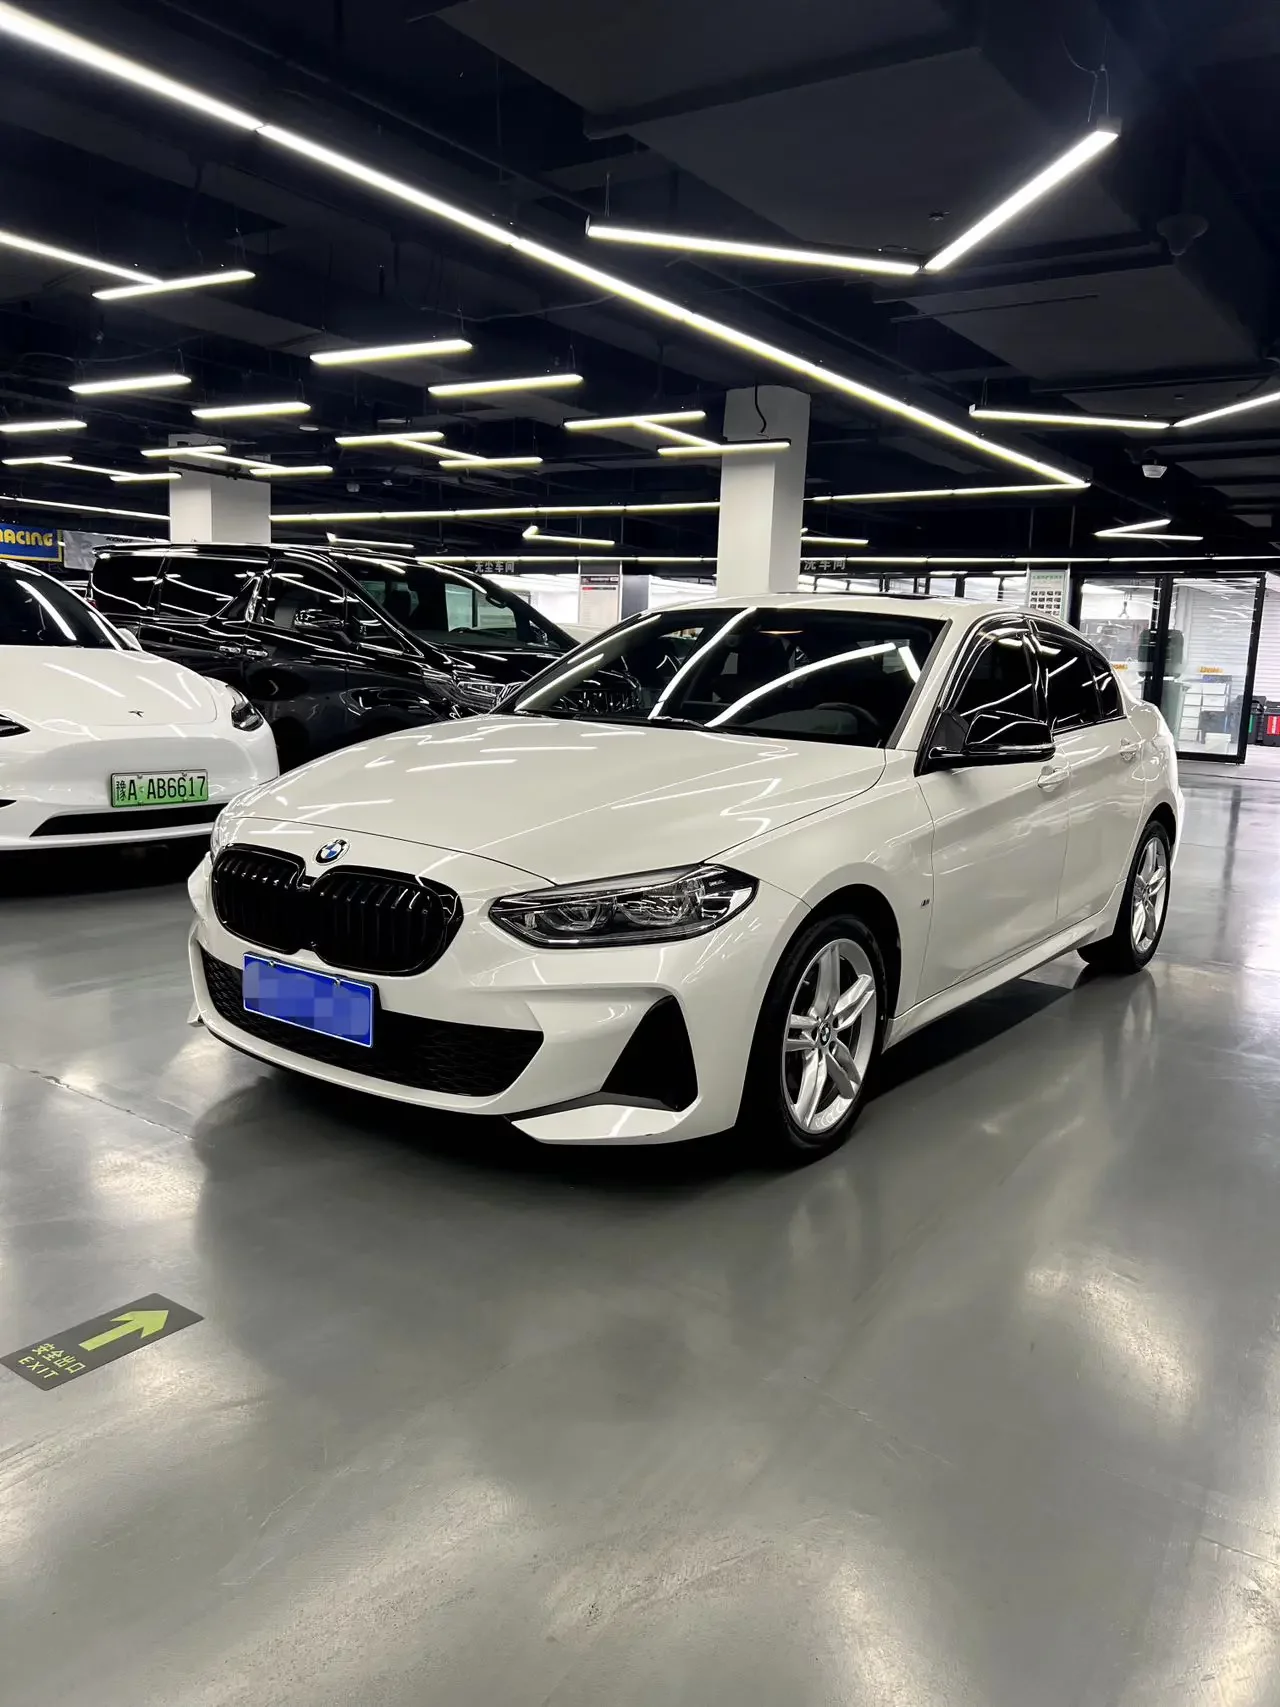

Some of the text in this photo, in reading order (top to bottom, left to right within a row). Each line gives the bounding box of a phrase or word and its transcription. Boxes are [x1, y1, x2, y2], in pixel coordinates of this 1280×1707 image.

[475, 560, 515, 573] 无尘车间
[18, 1356, 59, 1378] EXIT
[31, 1343, 86, 1374] 安全出口
